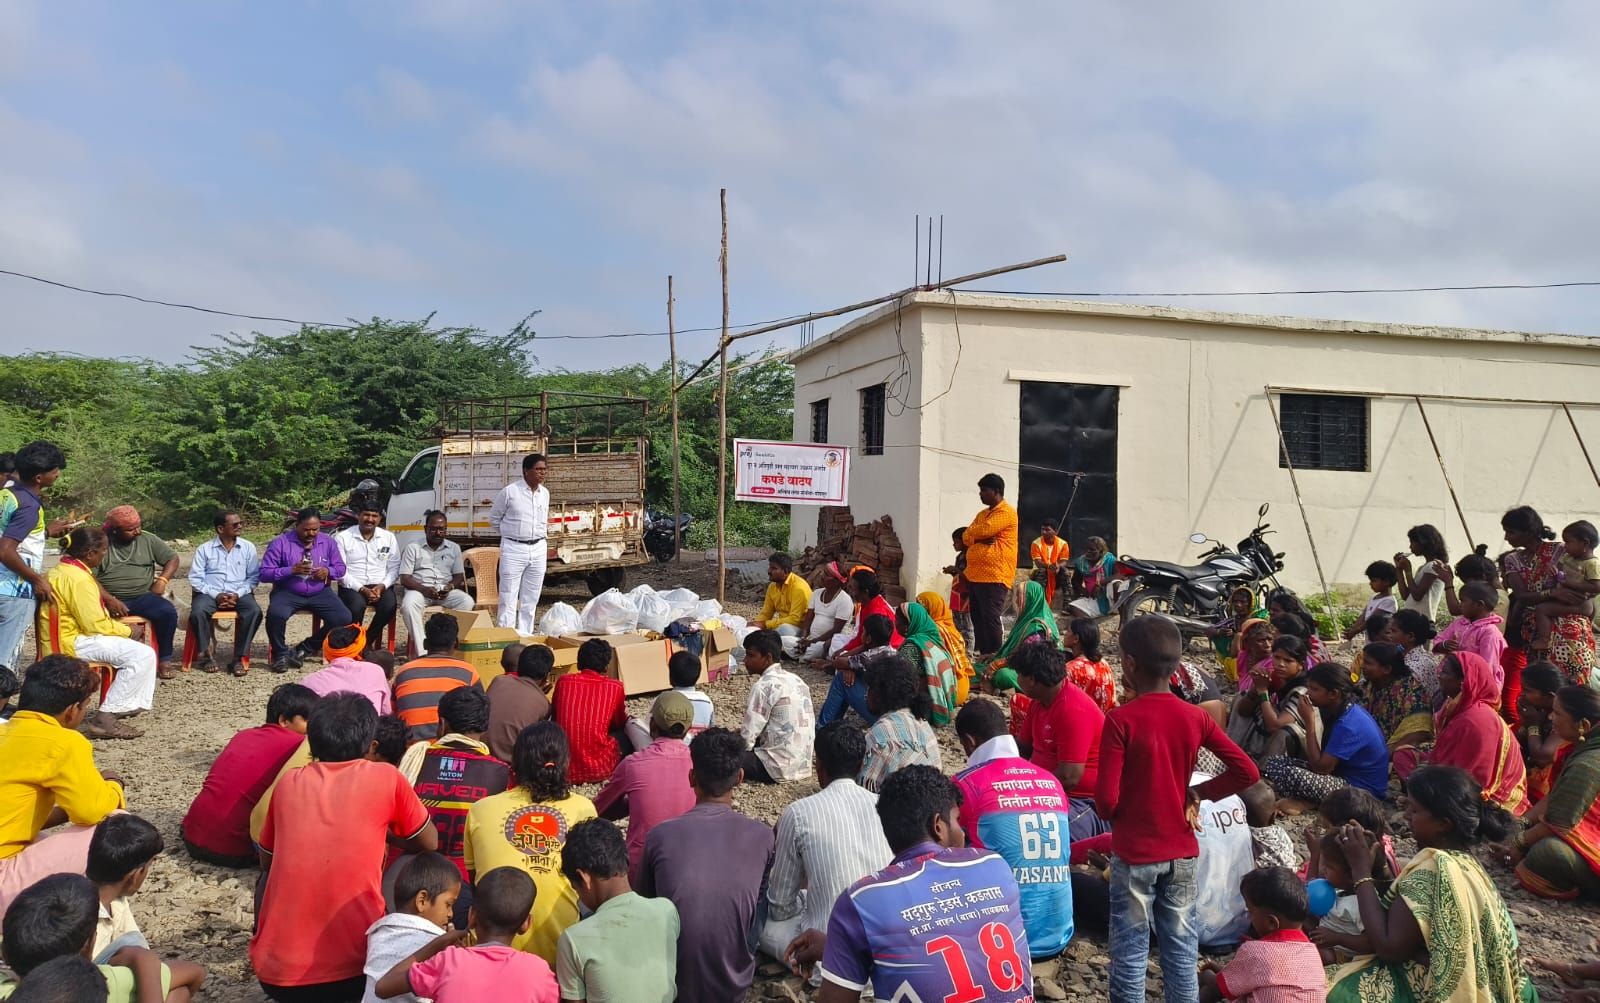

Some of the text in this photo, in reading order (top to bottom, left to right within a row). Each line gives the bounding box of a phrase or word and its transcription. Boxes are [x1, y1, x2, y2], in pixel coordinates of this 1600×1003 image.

[761, 472, 812, 487] कपडे वाटप
[992, 780, 1057, 792] समाधान पवार
[998, 794, 1032, 808] नितीन
[1018, 813, 1061, 860] 63
[964, 886, 1005, 904] कडलास
[935, 914, 956, 927] मोहन
[925, 921, 1024, 1003] 18
